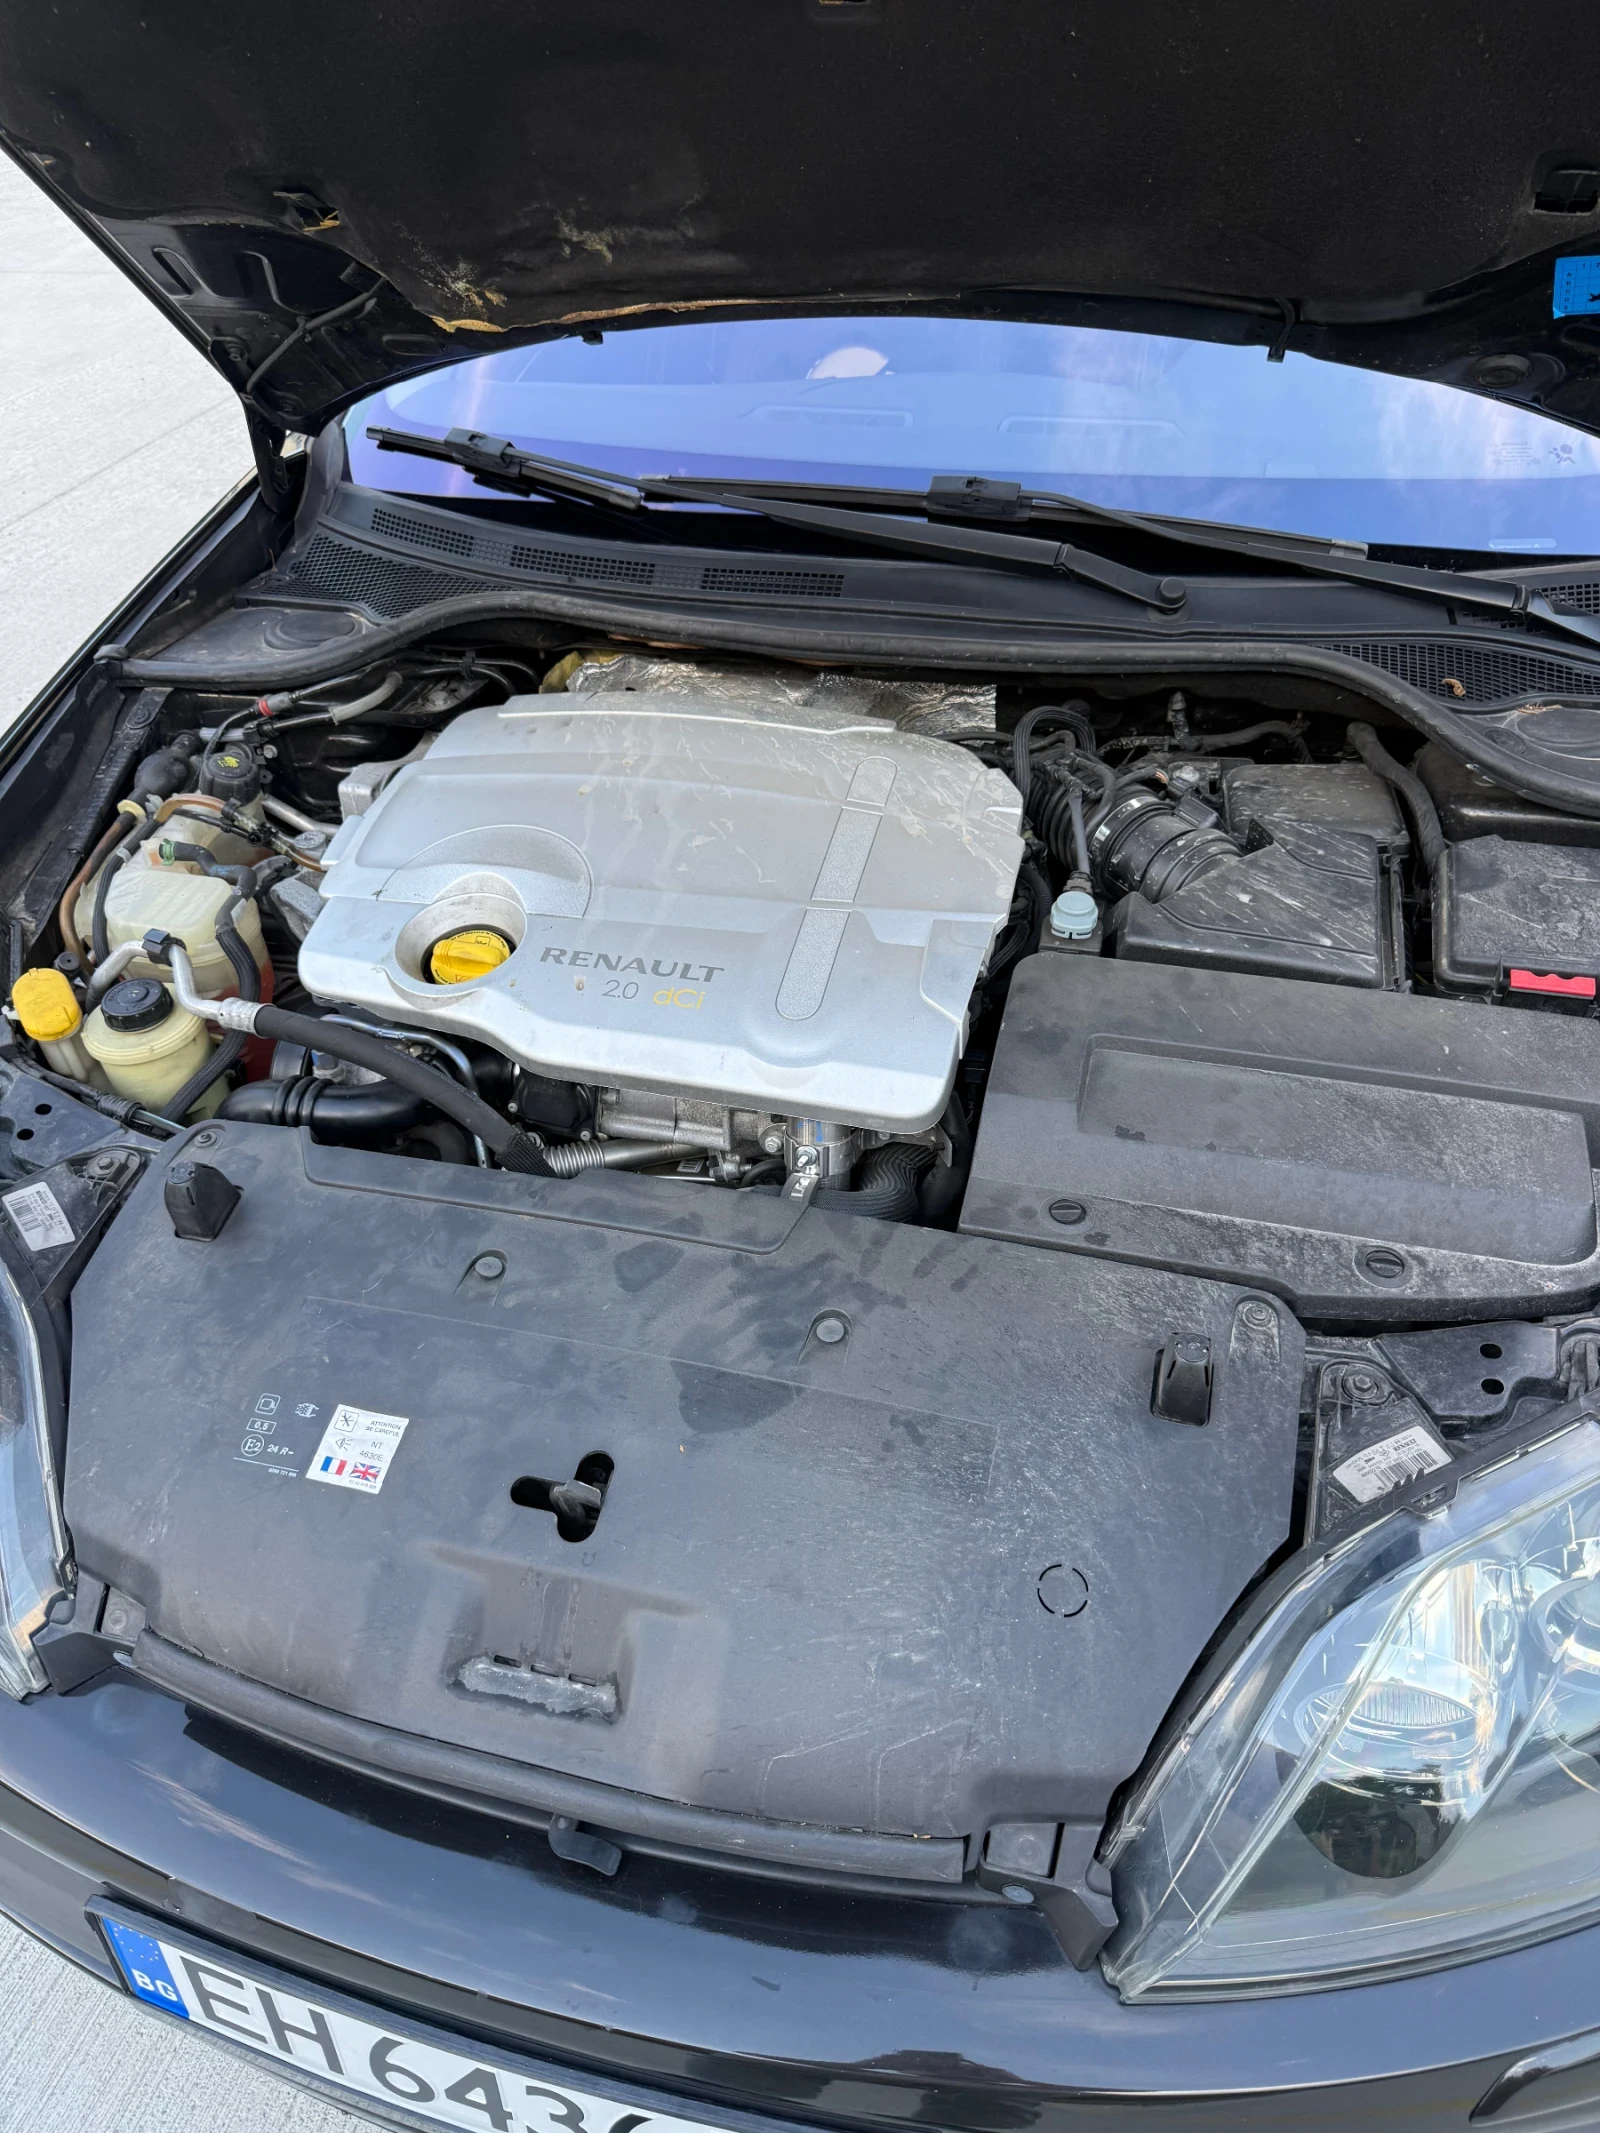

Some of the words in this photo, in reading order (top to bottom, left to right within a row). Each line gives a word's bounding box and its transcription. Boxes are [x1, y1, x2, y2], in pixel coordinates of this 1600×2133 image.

[539, 947, 725, 983] RENAULT
[602, 979, 640, 1000] 2.0
[652, 987, 706, 1010] dCi
[254, 1421, 269, 1431] 0,5
[370, 1420, 402, 1430] ATTENTION
[374, 1427, 401, 1438] CAREFUL
[244, 1439, 261, 1452] E2
[266, 1445, 279, 1453] 24
[370, 1440, 384, 1449] NT
[359, 1450, 384, 1462] 4630E
[135, 1968, 179, 2002] BG
[178, 1954, 343, 2076] EH
